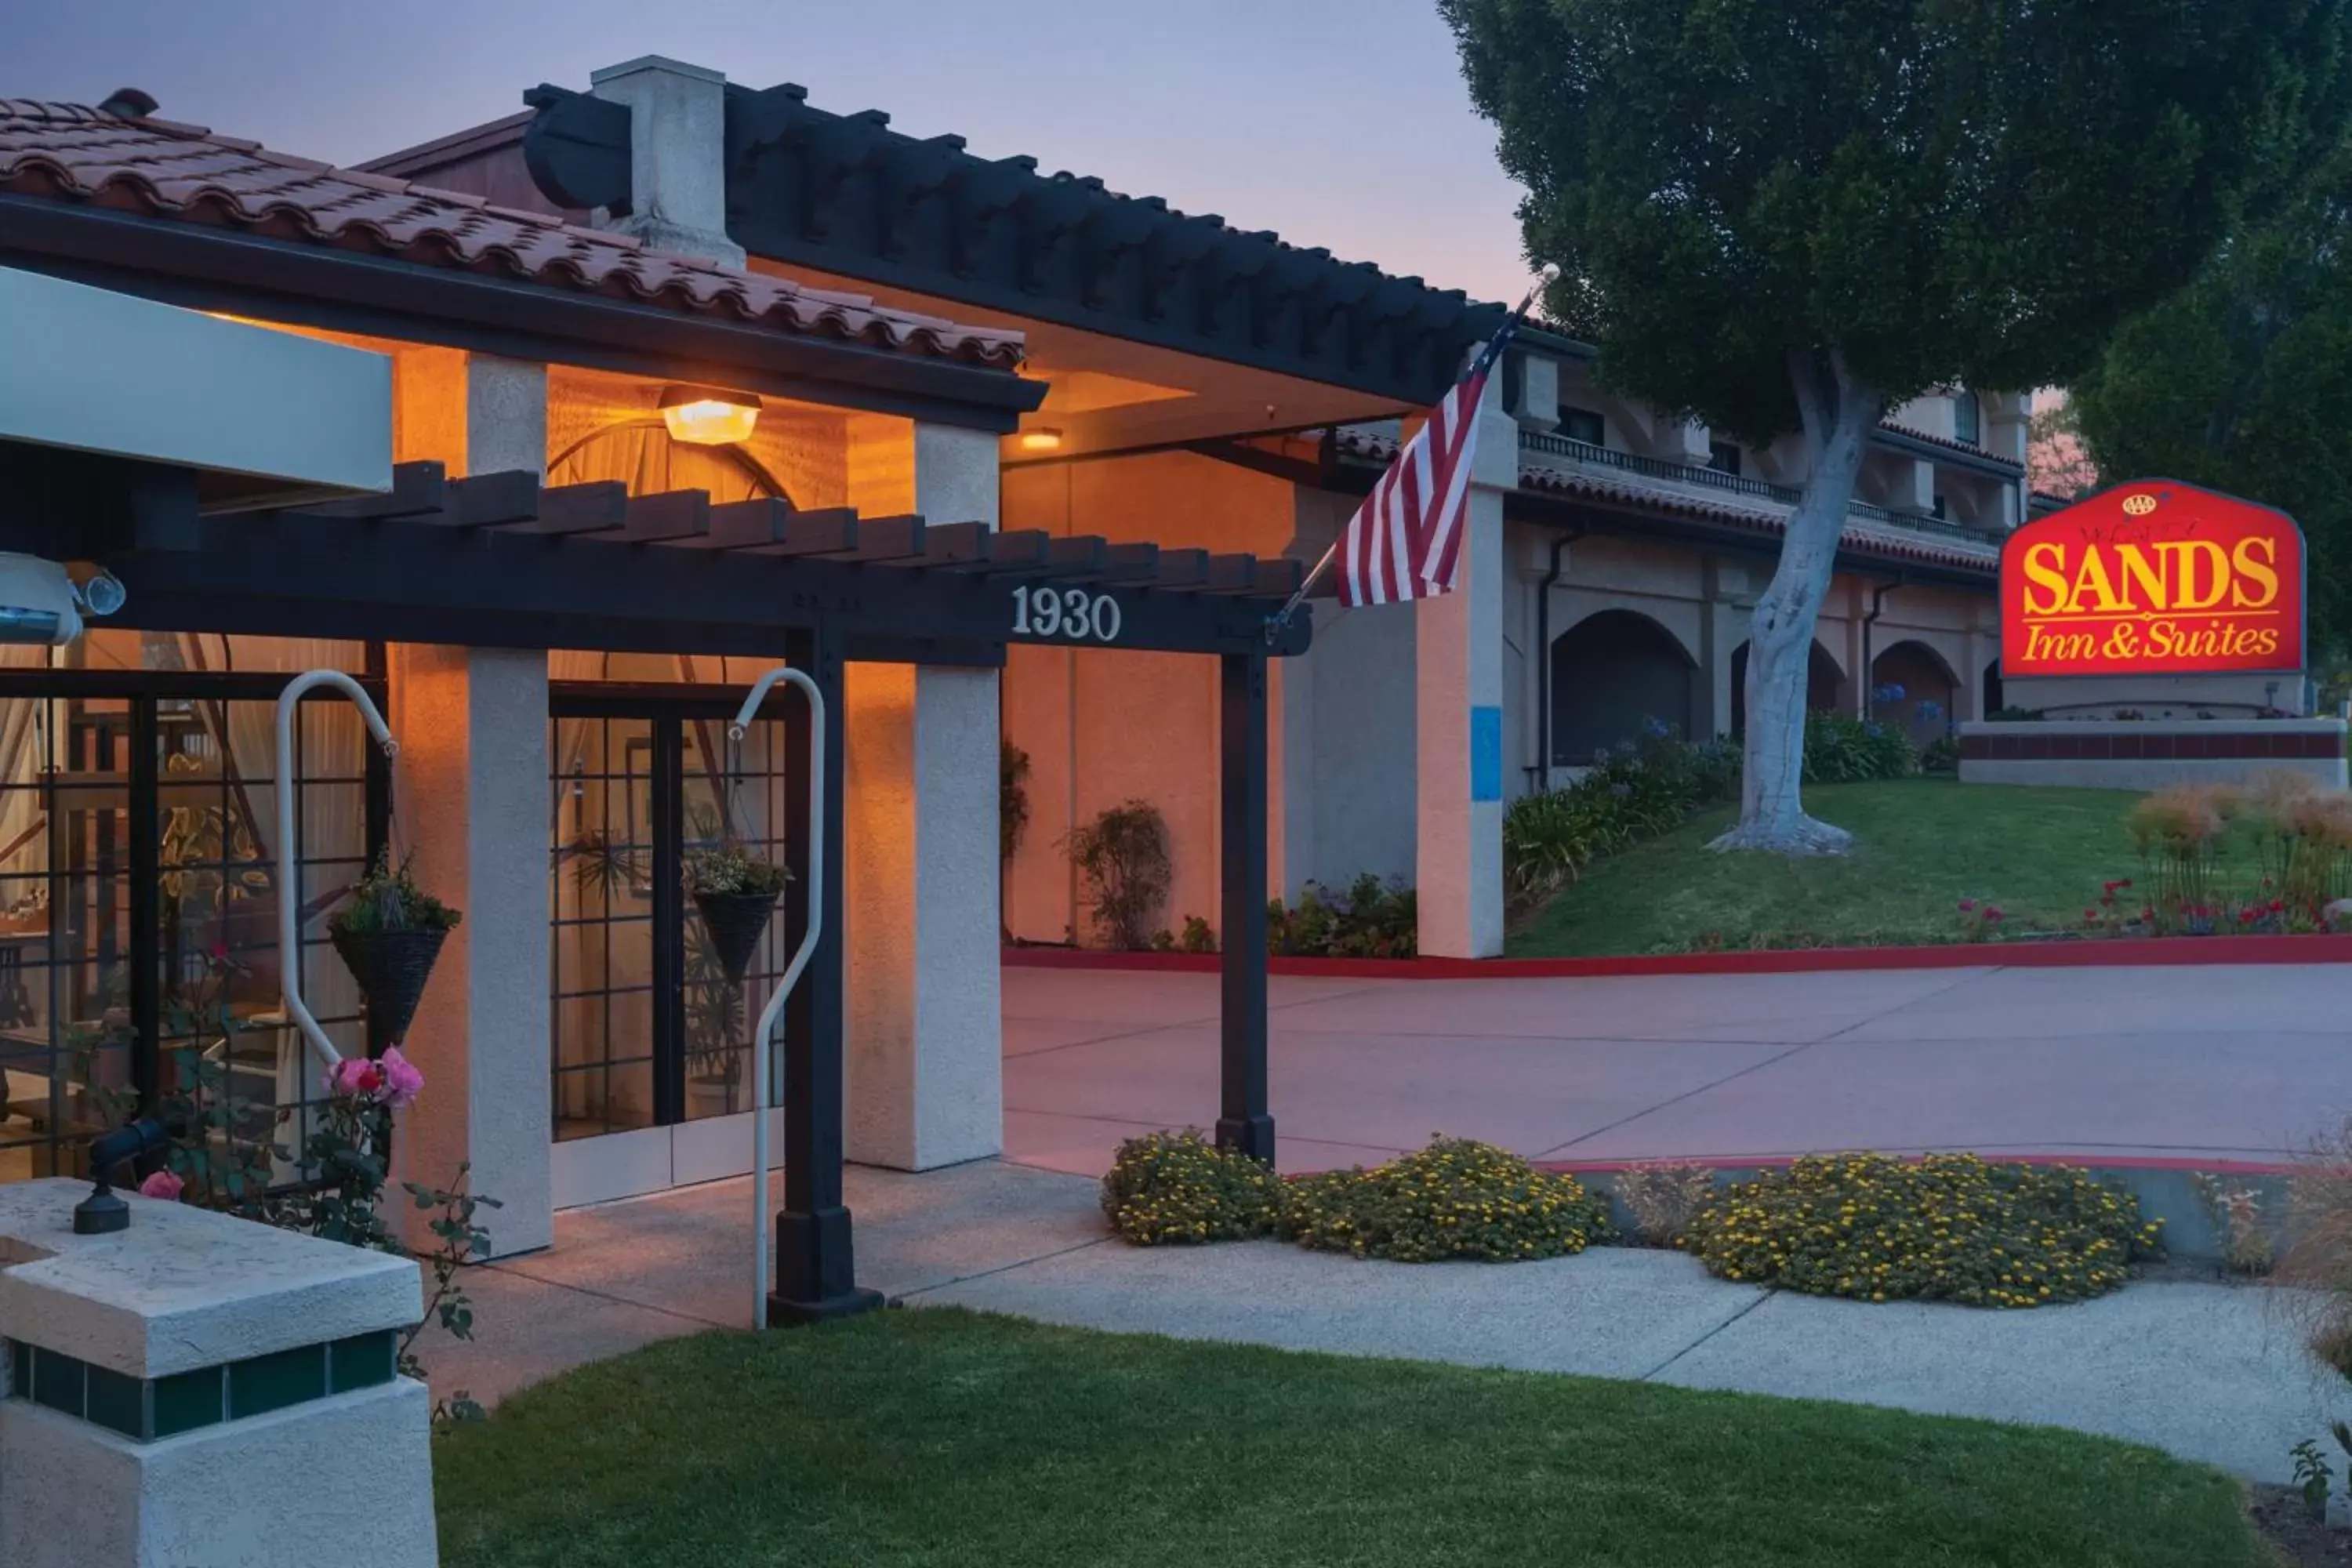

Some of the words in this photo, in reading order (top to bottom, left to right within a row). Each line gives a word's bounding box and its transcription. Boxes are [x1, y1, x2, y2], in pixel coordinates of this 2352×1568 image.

[2023, 536, 2278, 615] SANDS
[1011, 586, 1121, 641] 1930
[2022, 625, 2097, 661] Inn
[2102, 622, 2140, 659] &
[2143, 620, 2278, 659] Suites
